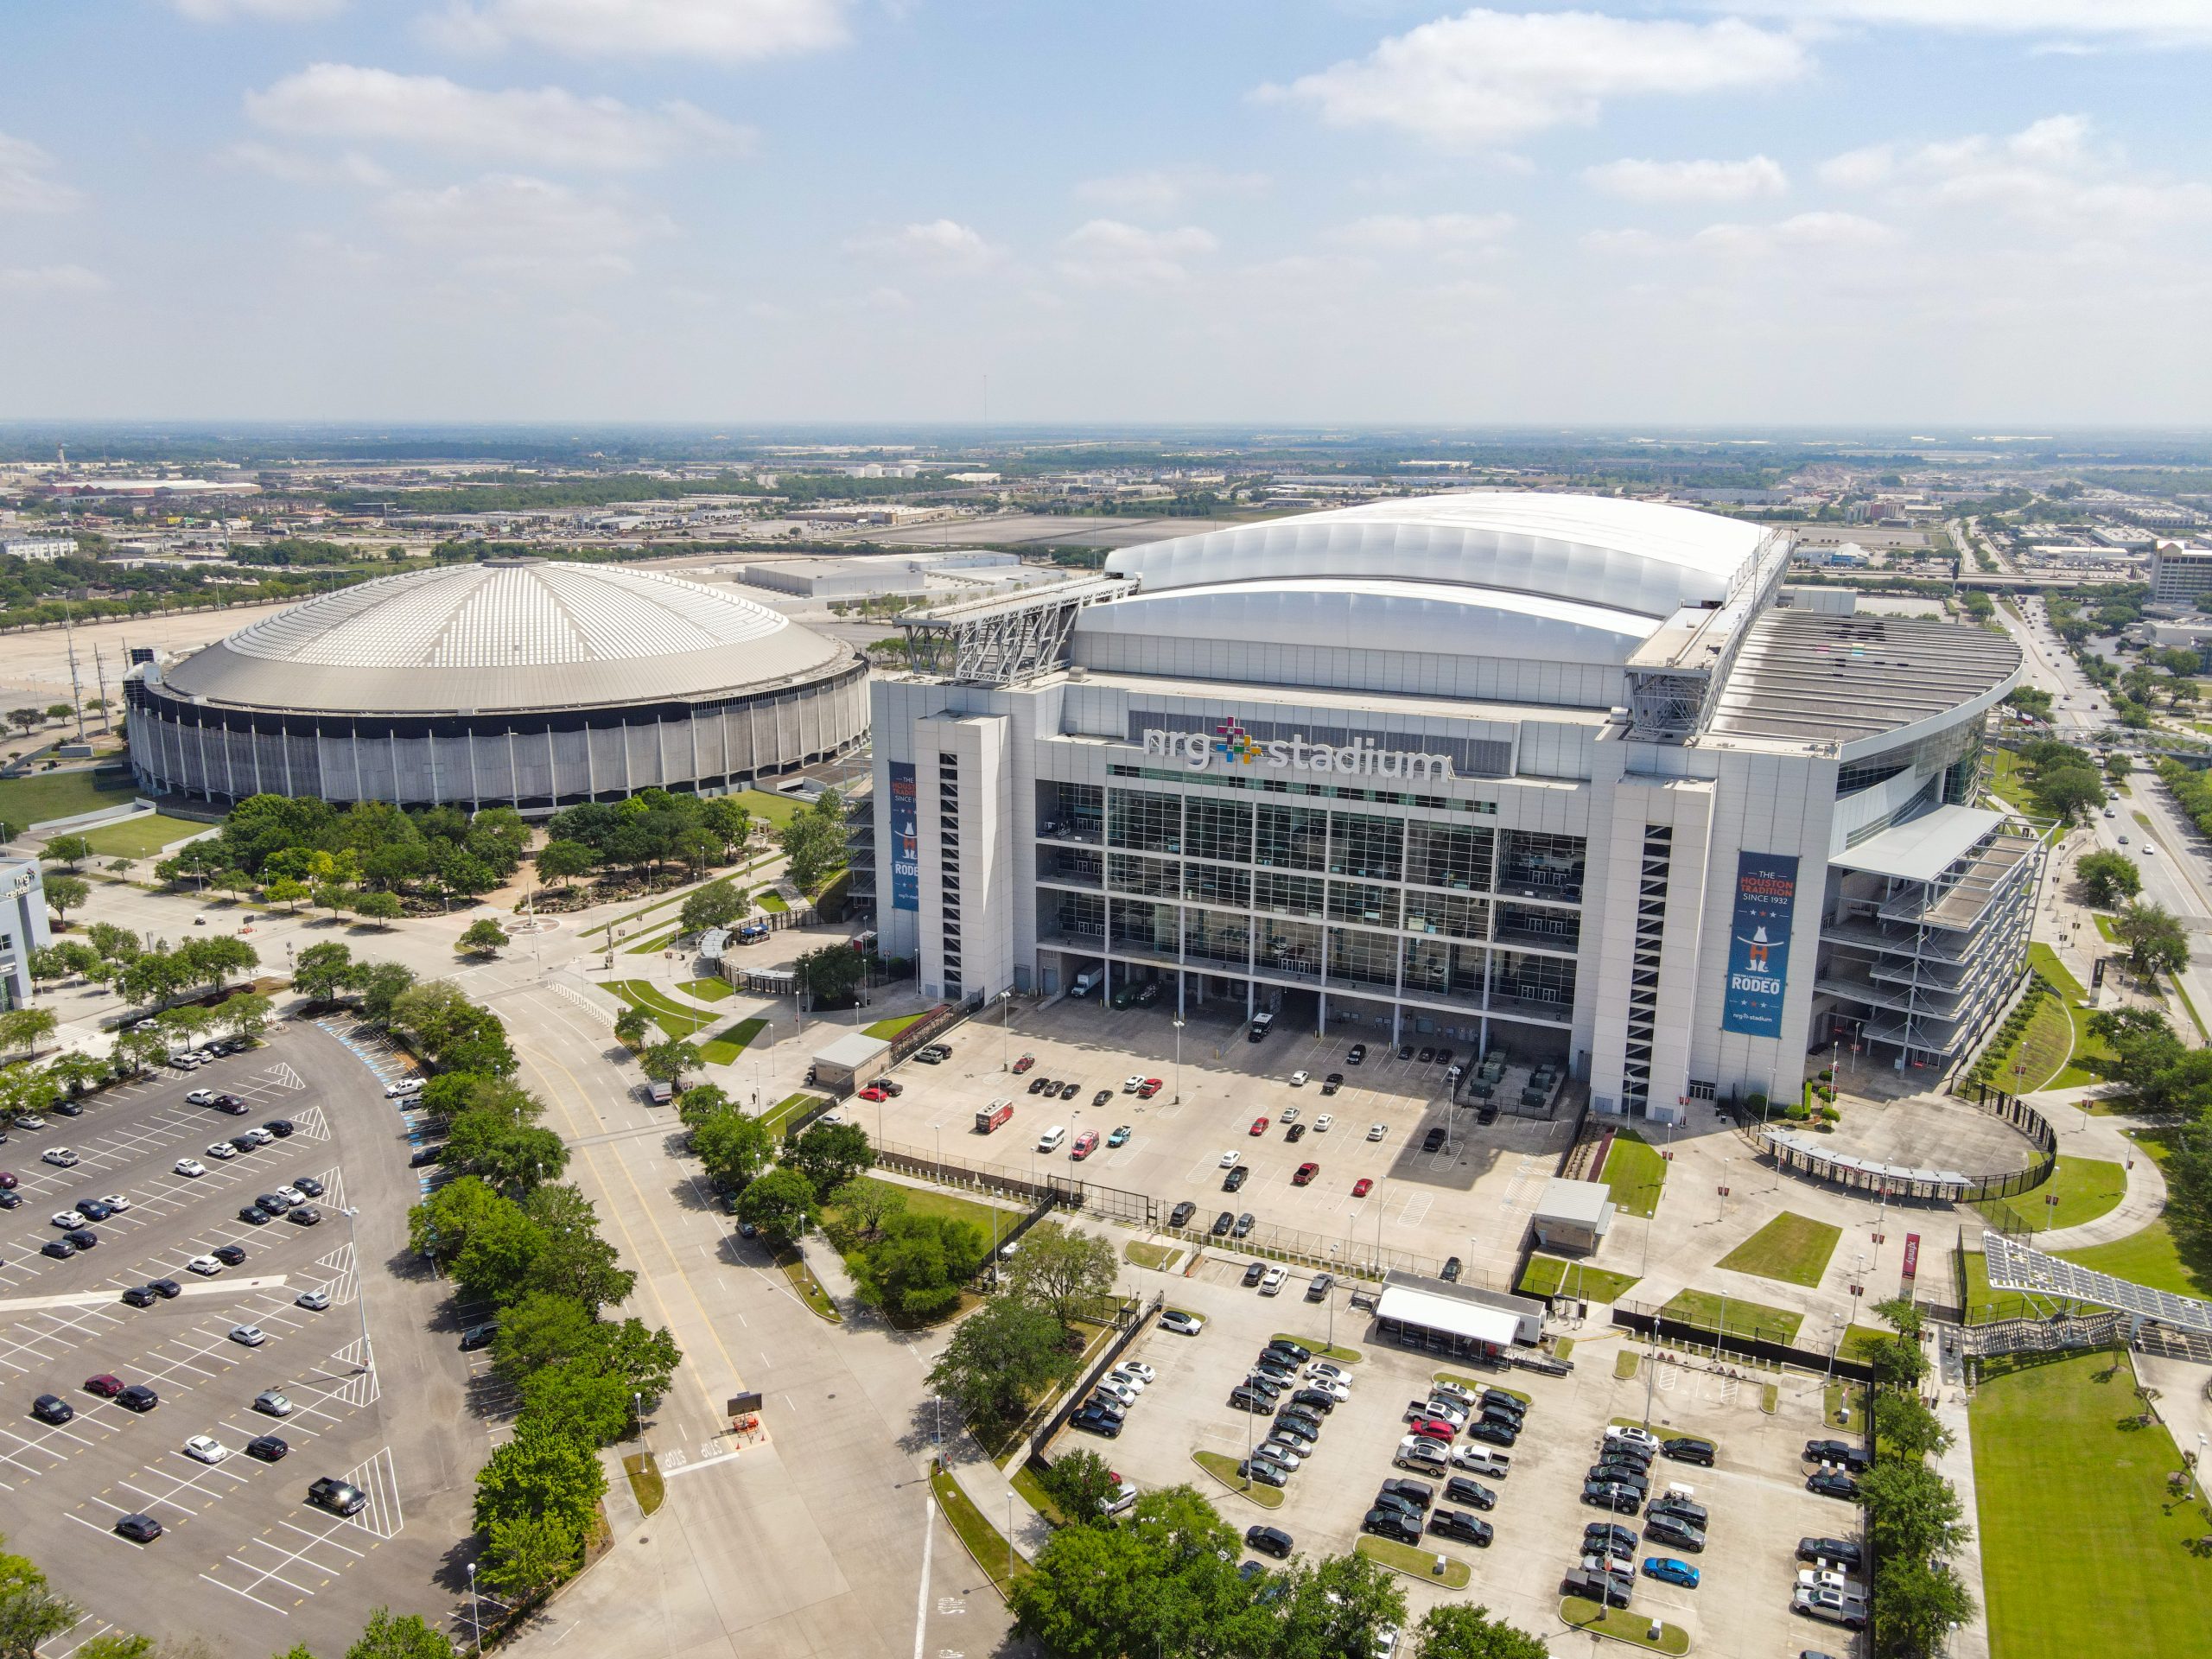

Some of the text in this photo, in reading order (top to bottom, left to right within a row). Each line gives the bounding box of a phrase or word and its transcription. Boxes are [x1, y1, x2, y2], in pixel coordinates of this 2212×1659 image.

[1143, 728, 1451, 782] nrg stadium
[1741, 876, 1794, 889] HOUSTON
[1758, 870, 1776, 880] THE
[1741, 884, 1793, 898] TRADITION
[1743, 893, 1789, 905] SINCE 1932
[1732, 976, 1780, 995] RODEO
[701, 1440, 723, 1459] STOP
[664, 1448, 688, 1468] STOP
